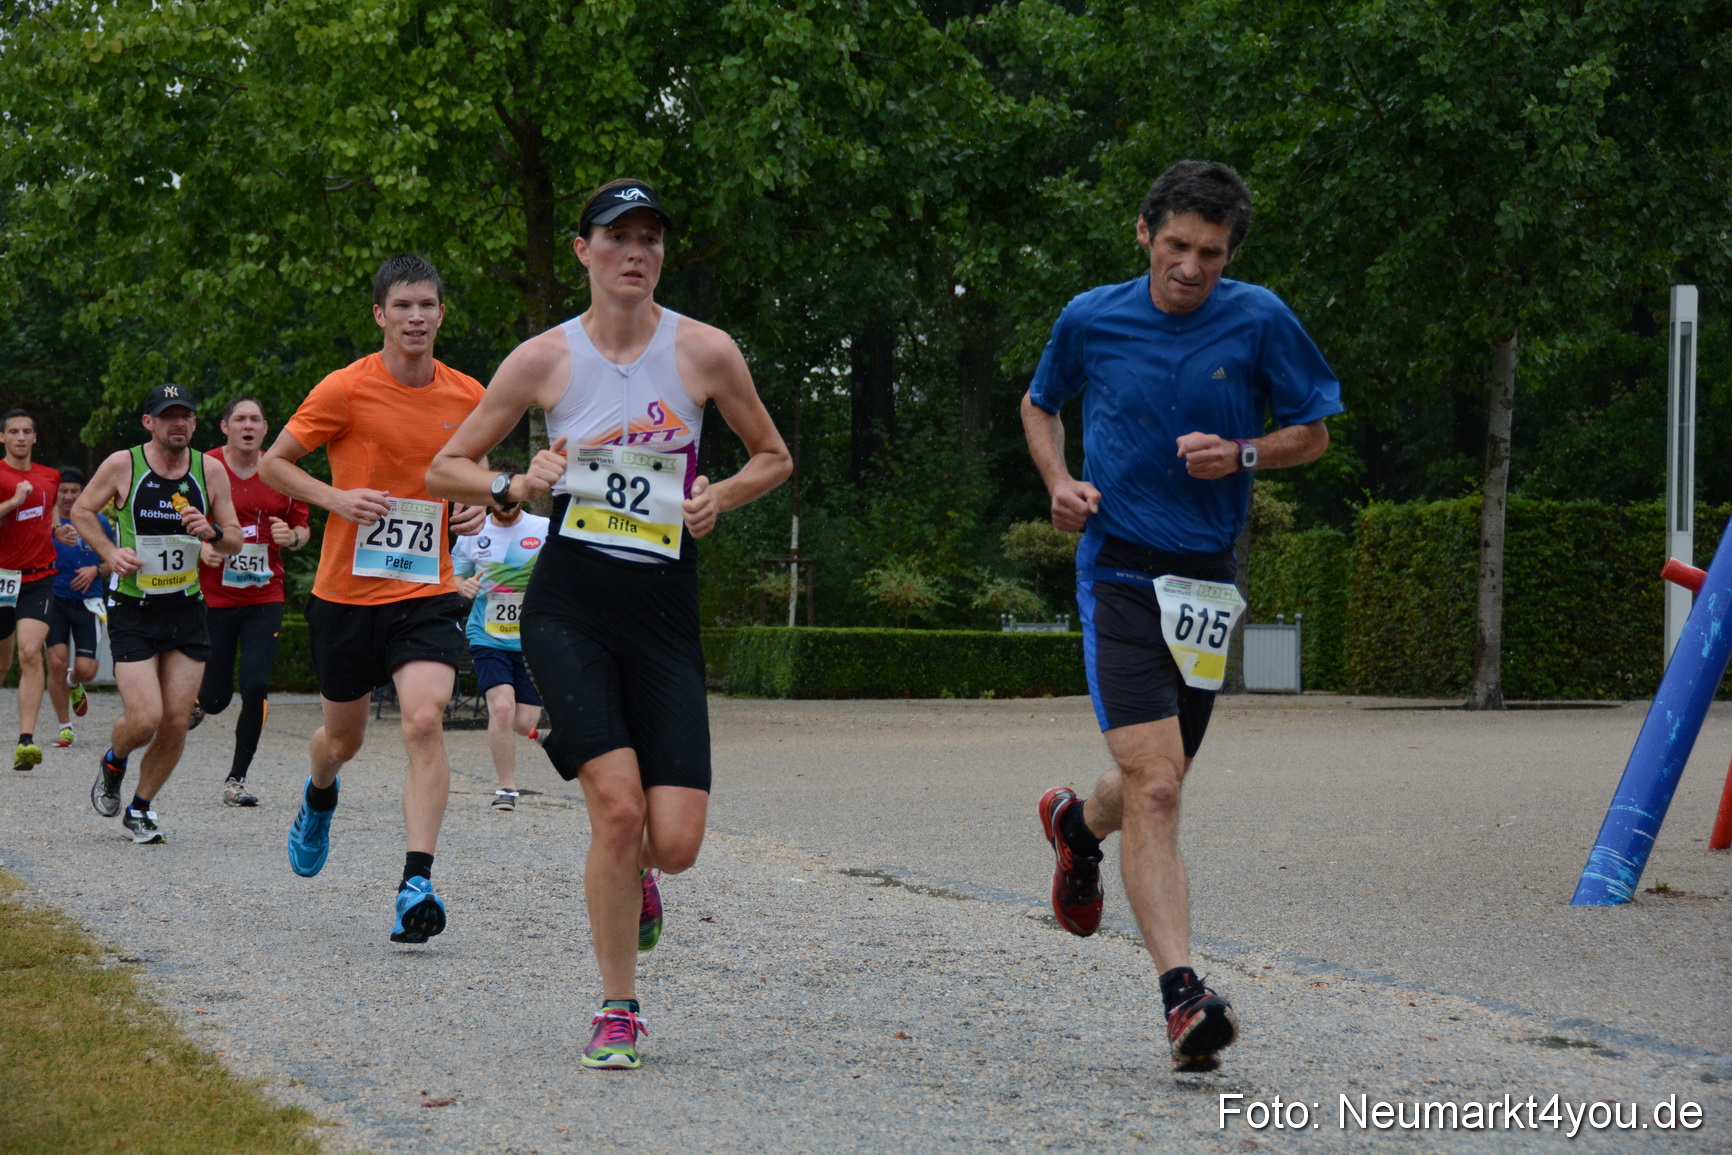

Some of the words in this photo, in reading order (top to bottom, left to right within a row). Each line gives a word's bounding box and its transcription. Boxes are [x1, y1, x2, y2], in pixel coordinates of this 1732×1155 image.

[606, 472, 651, 516] 82
[140, 509, 183, 520] Röthenb
[401, 501, 437, 516] BOCK
[607, 516, 638, 533] Rita
[366, 517, 434, 552] 2573
[158, 549, 184, 572] 13
[229, 555, 265, 573] 2551
[385, 555, 413, 570] Peter
[151, 575, 187, 587] Christian
[1175, 603, 1231, 649] 615
